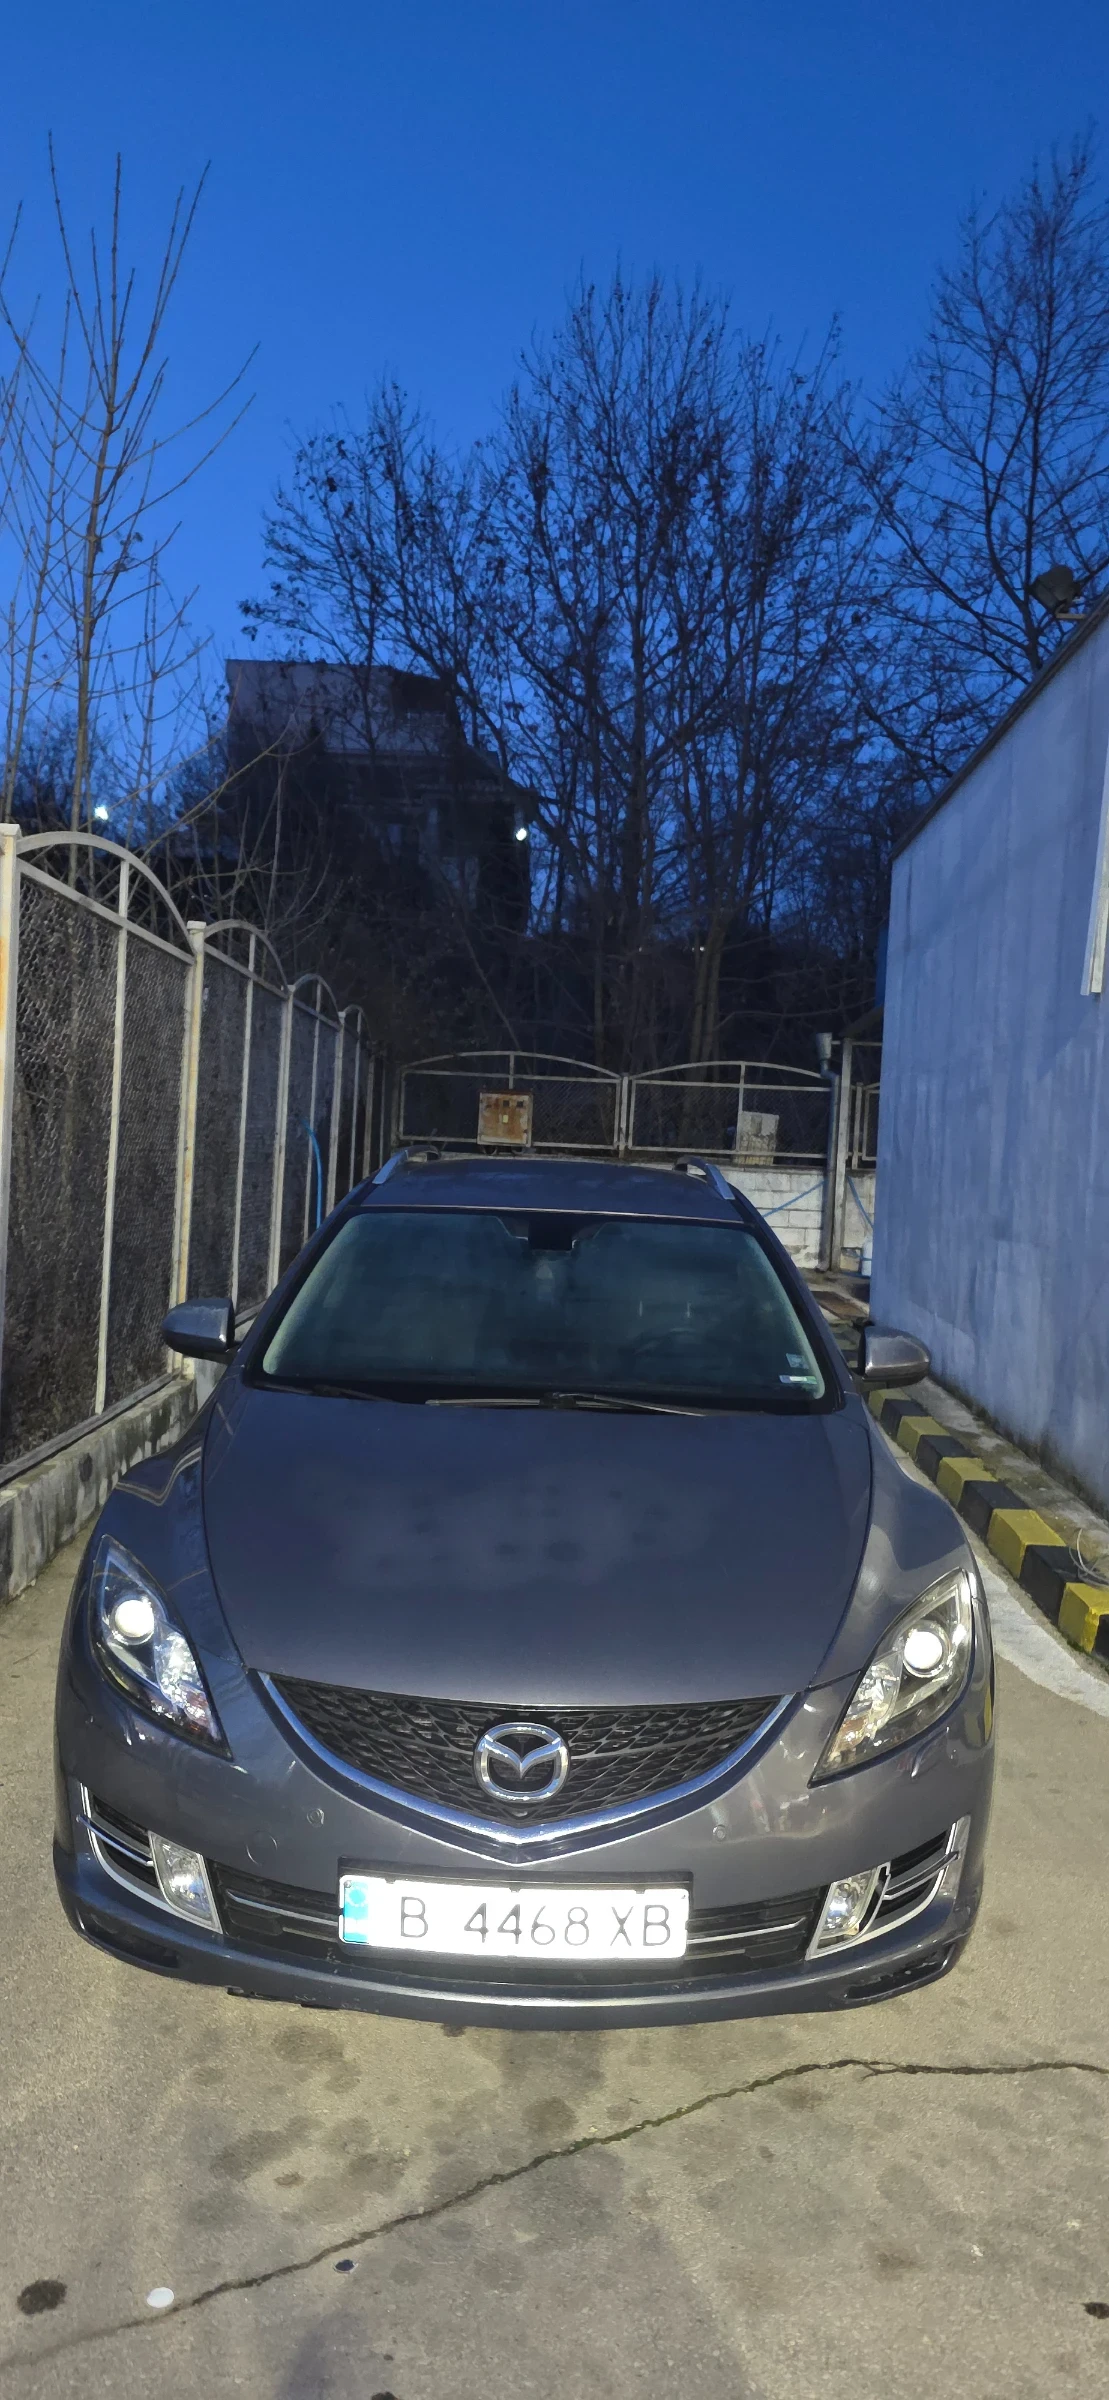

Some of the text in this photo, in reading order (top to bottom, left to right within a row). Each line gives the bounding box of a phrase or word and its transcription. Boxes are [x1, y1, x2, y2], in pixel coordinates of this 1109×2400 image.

[400, 1896, 671, 1947] B 4468 XB
